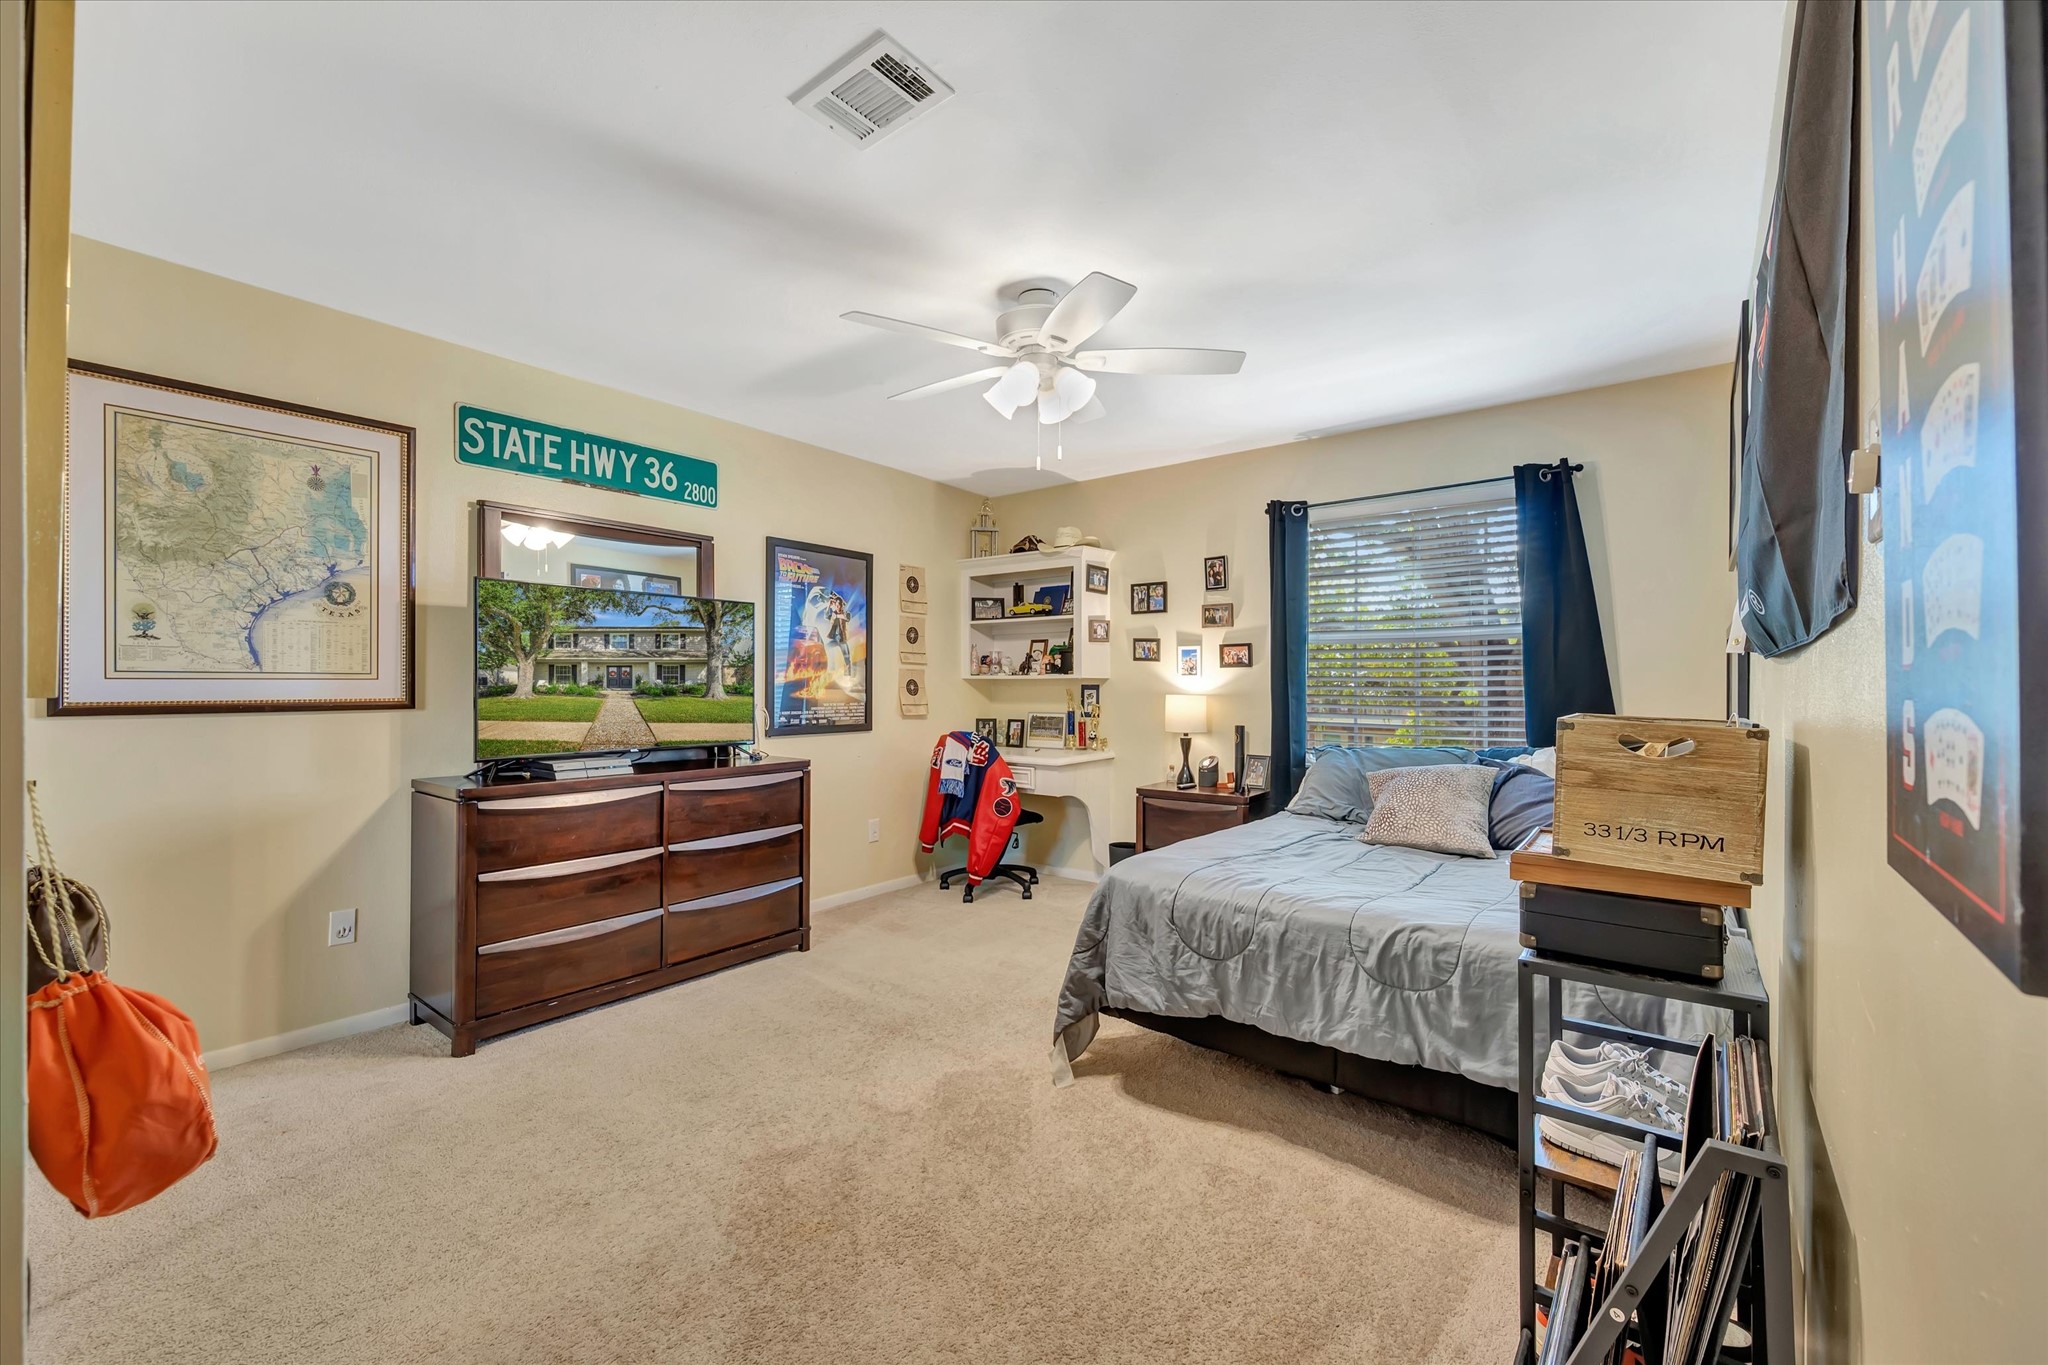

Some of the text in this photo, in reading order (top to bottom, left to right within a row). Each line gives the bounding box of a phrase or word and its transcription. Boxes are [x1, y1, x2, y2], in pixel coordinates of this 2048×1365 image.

[462, 417, 678, 492] STATE HWY 36
[684, 482, 716, 505] 2800
[322, 606, 361, 618] TEXAS
[1657, 830, 1725, 852] RPM
